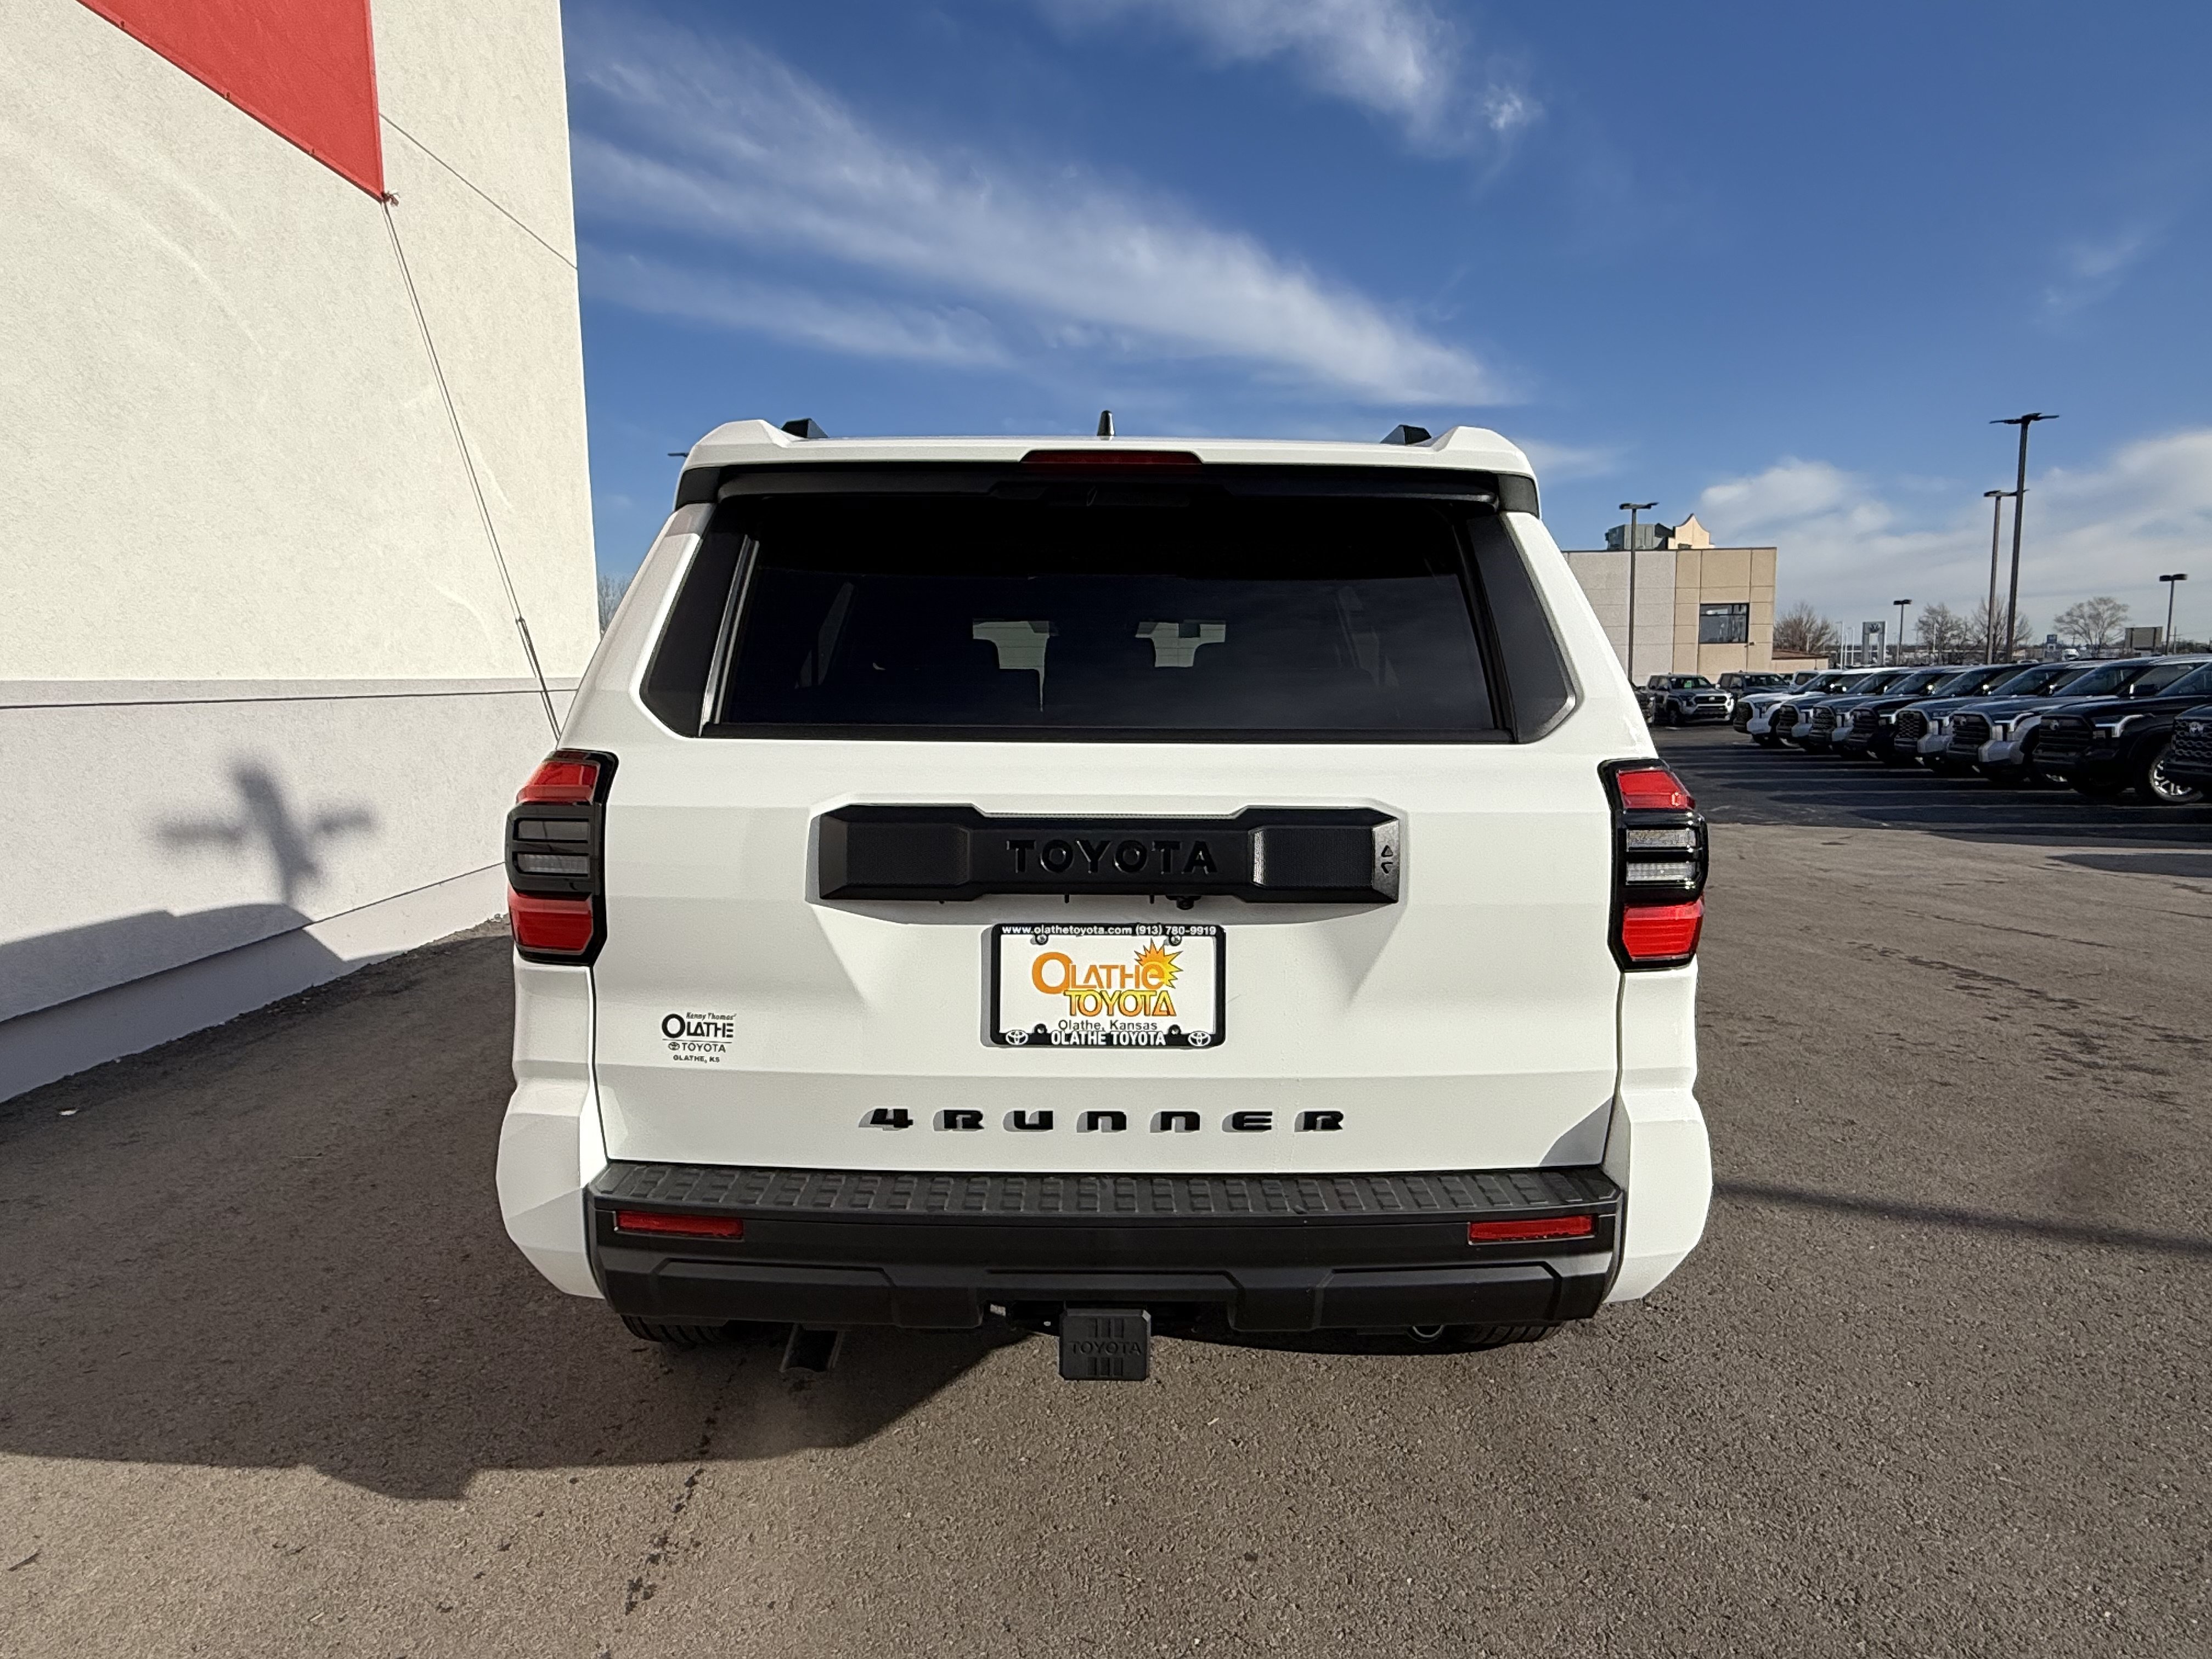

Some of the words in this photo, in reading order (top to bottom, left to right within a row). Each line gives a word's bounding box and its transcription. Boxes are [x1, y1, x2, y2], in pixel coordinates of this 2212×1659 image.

[1006, 839, 1217, 874] TOYOTA
[1002, 926, 1132, 936] www.olathetoyota.com
[1136, 924, 1162, 935] (913)
[1064, 990, 1177, 1016] TOYOTA
[662, 1013, 733, 1039] OLATHE
[1058, 1019, 1105, 1031] Olathe,
[1110, 1019, 1158, 1030] Kansas
[1051, 1030, 1106, 1045] OLATHE
[1110, 1030, 1166, 1045] TOYOTA
[681, 1042, 726, 1053] TOYOTA
[673, 1054, 707, 1063] OLATHE,
[1069, 1341, 1142, 1356] TOYOTA
